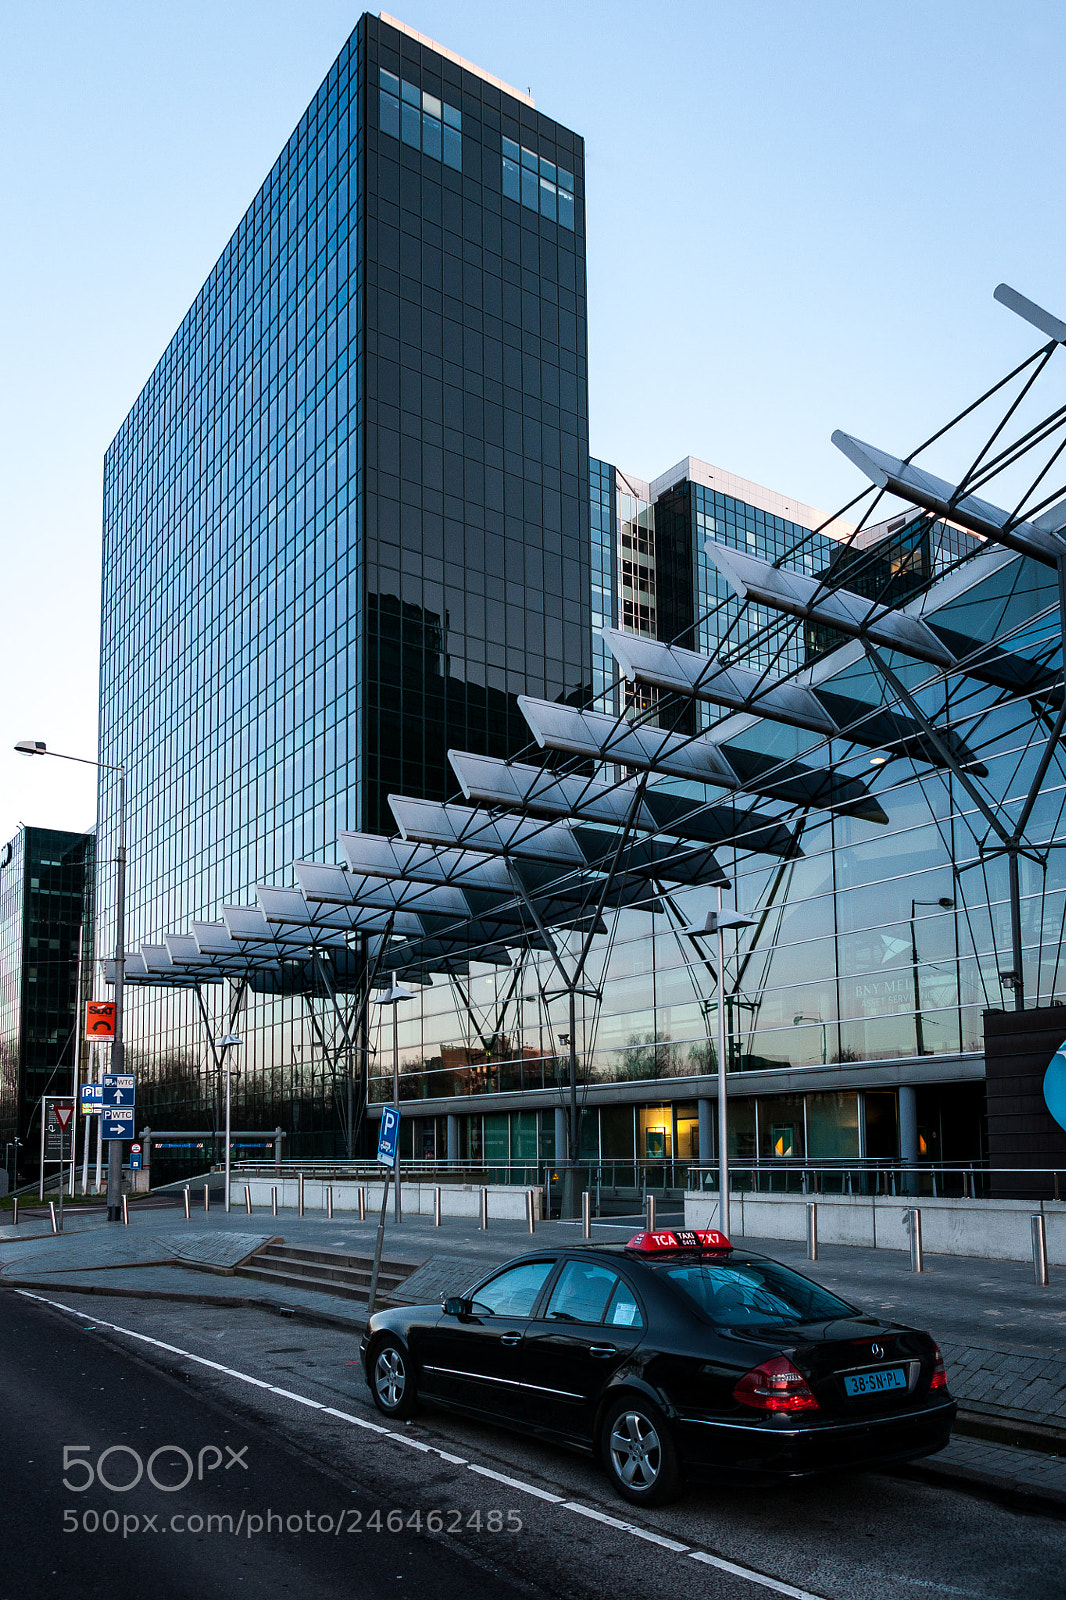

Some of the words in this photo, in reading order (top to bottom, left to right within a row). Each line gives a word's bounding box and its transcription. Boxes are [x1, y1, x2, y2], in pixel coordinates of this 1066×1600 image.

[89, 1005, 114, 1015] SIXT
[104, 1110, 111, 1119] P
[113, 1111, 132, 1119] WTC
[384, 1112, 395, 1136] P
[652, 1235, 677, 1246] TCA
[677, 1232, 695, 1240] TAXI
[851, 1371, 901, 1393] 38-SN-PL
